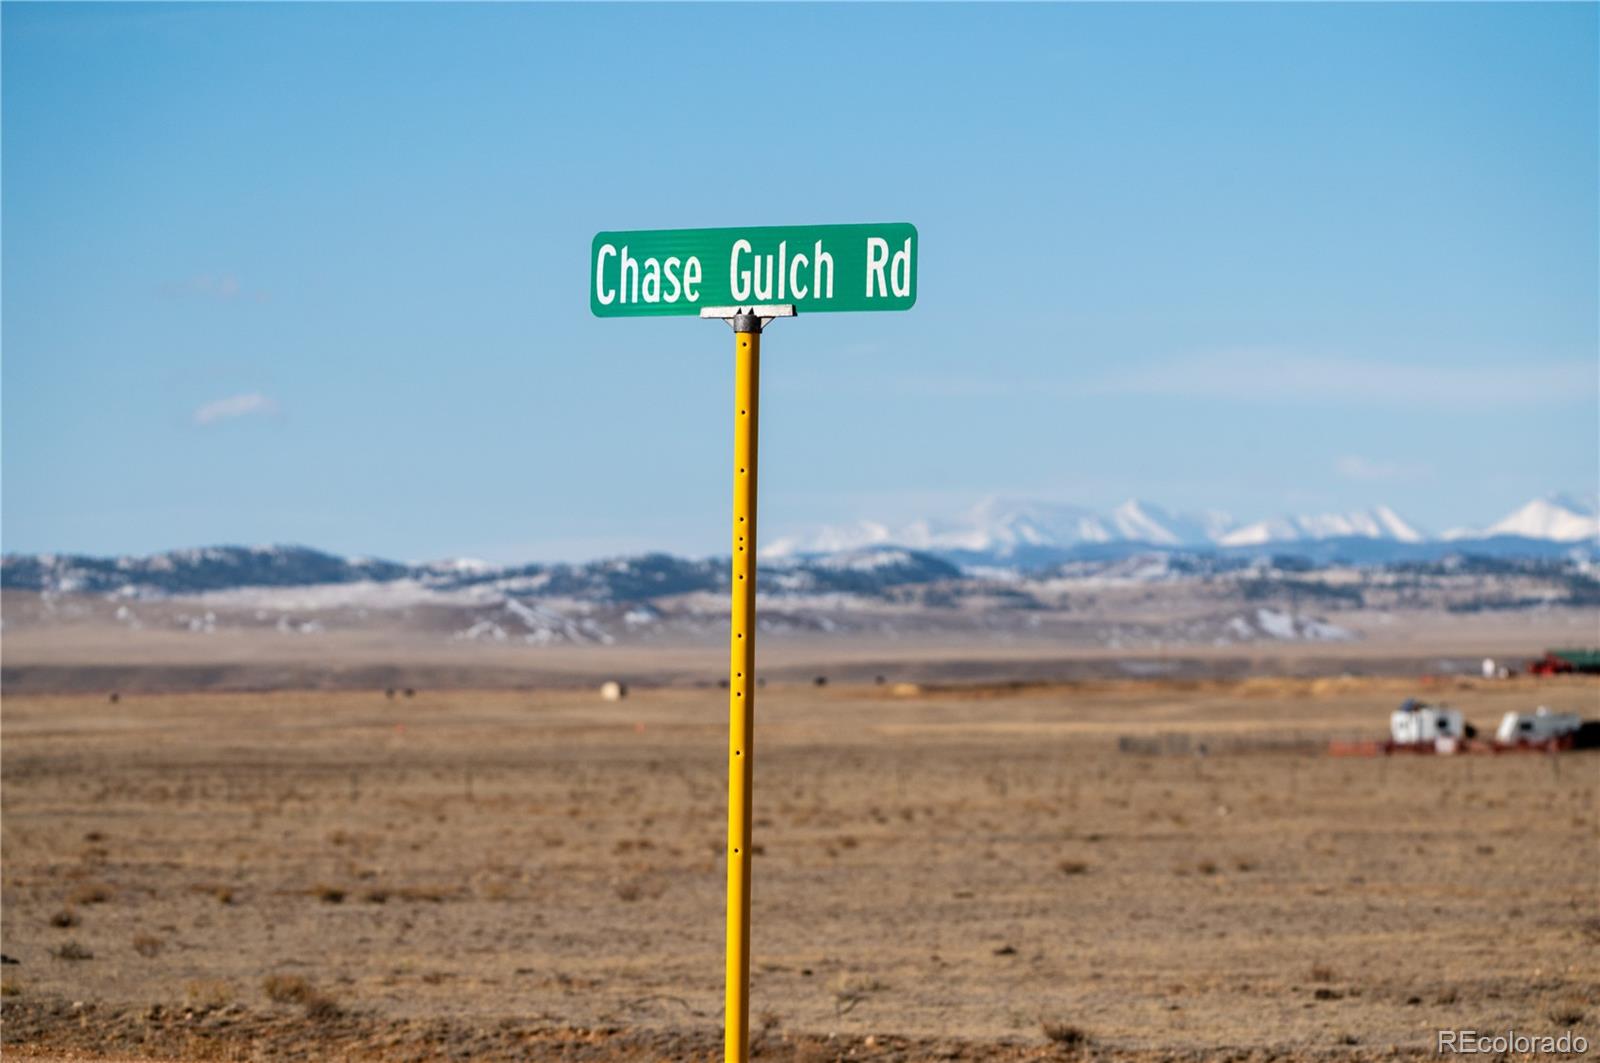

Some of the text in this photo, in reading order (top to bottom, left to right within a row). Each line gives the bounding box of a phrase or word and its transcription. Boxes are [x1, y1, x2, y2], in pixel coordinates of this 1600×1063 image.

[596, 237, 911, 305] Chase Gulch Rd
